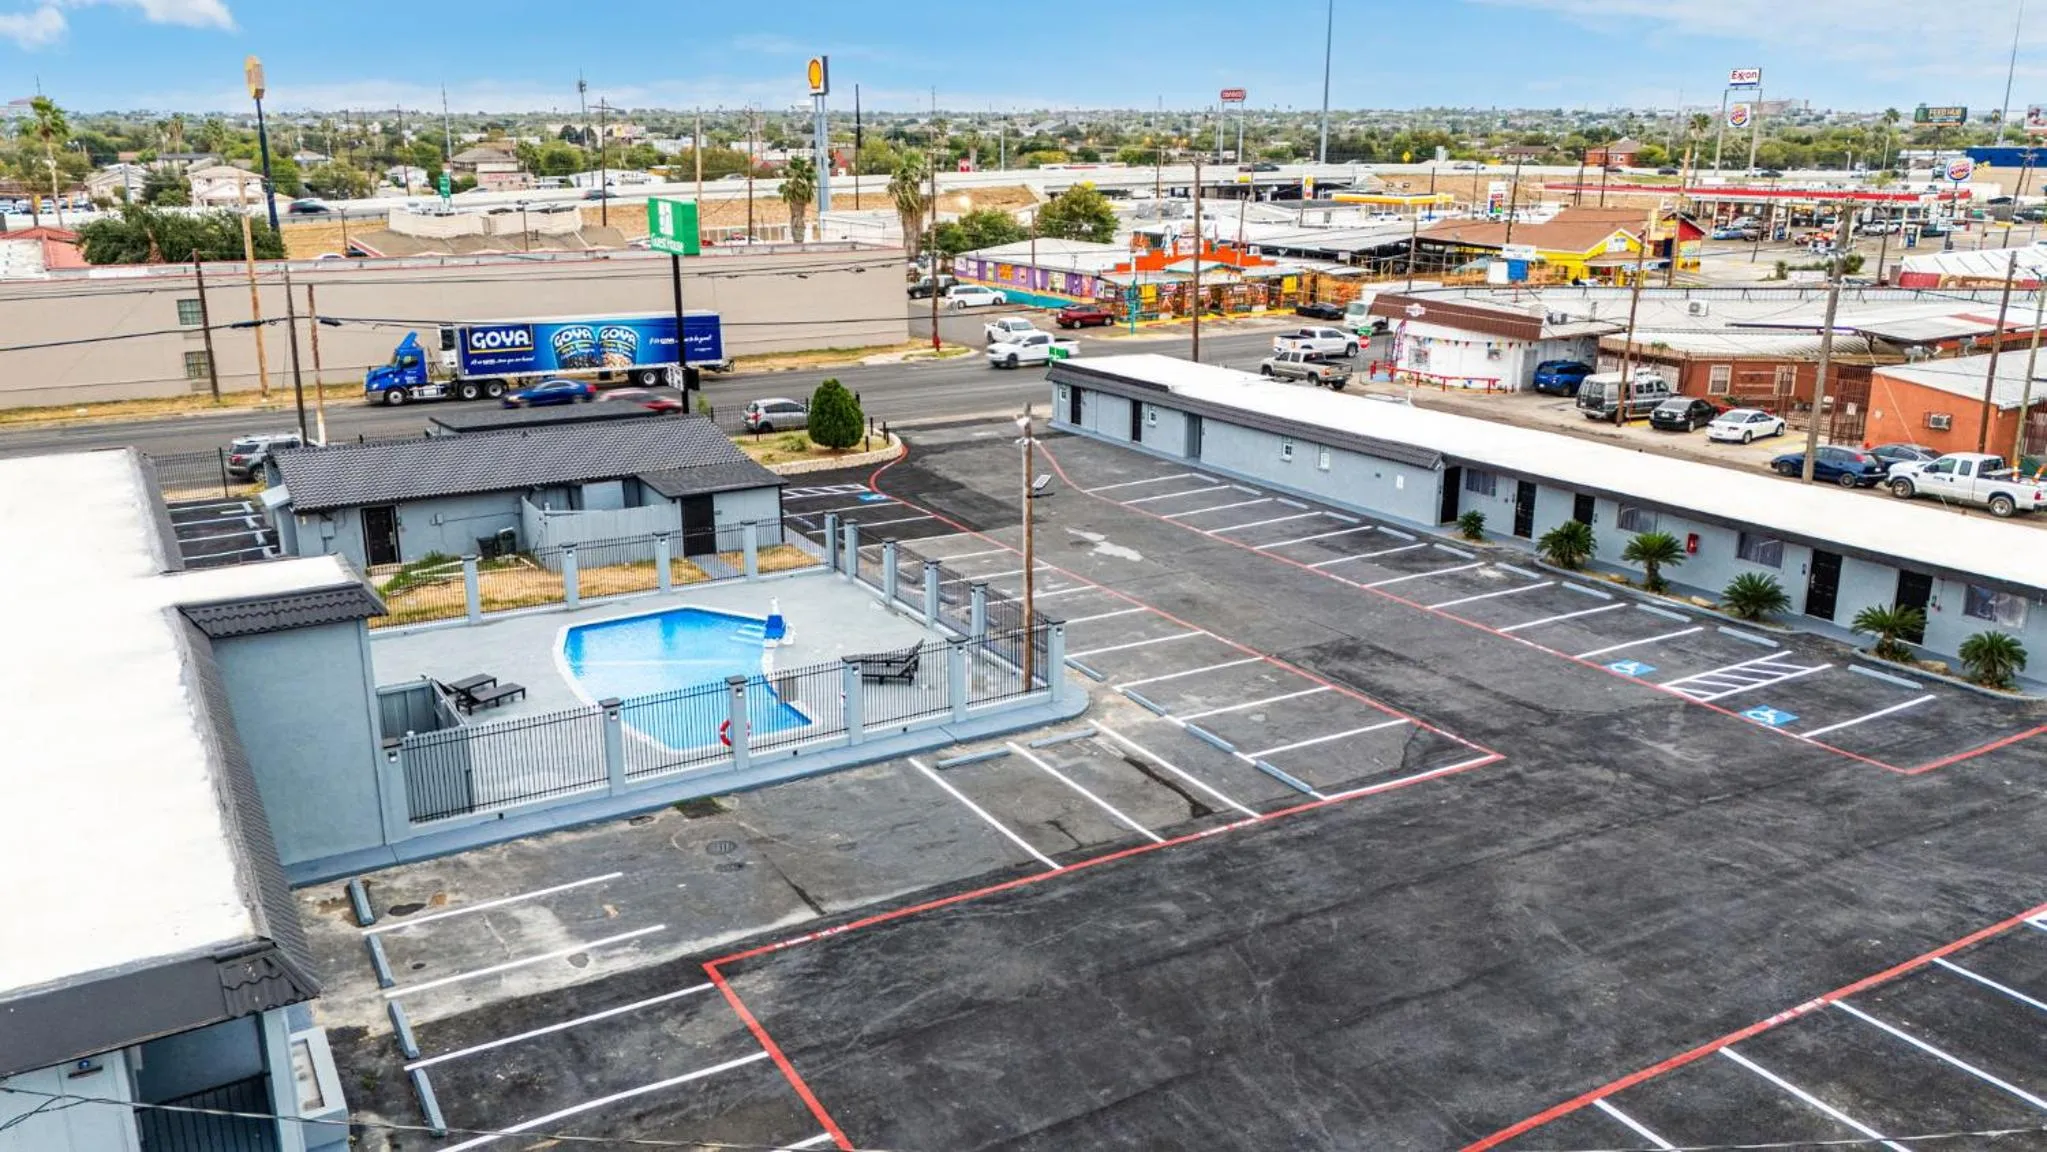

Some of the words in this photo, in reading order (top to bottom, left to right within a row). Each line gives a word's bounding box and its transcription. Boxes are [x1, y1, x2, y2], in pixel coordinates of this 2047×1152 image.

[1731, 70, 1757, 80] Exxon
[471, 330, 530, 348] GOYA
[554, 328, 593, 347] GOYA
[601, 328, 636, 346] GOYA
